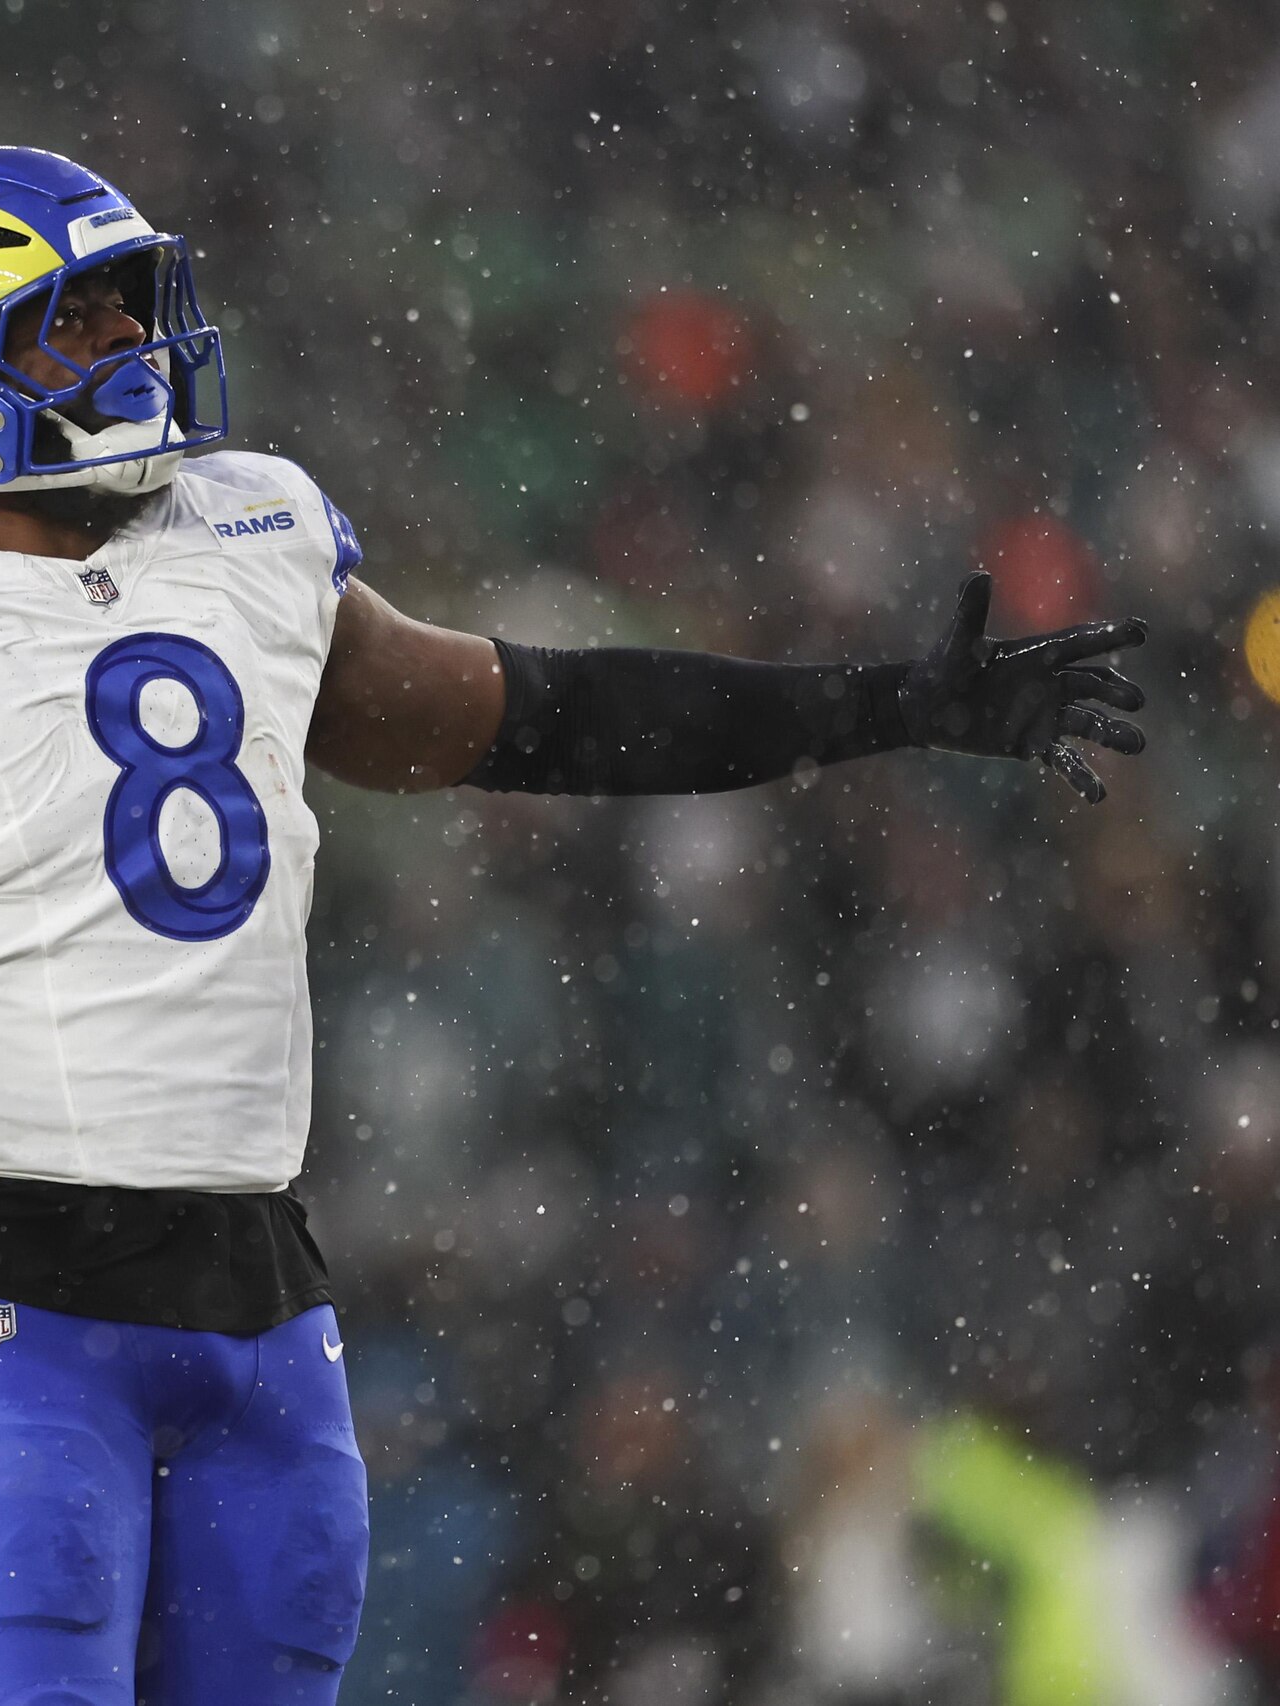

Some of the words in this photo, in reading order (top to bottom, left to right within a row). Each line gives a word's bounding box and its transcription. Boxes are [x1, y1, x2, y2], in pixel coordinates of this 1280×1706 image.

[89, 208, 135, 228] RAMS
[213, 511, 295, 538] RAMS
[87, 582, 117, 600] NFL
[85, 632, 271, 942] 8
